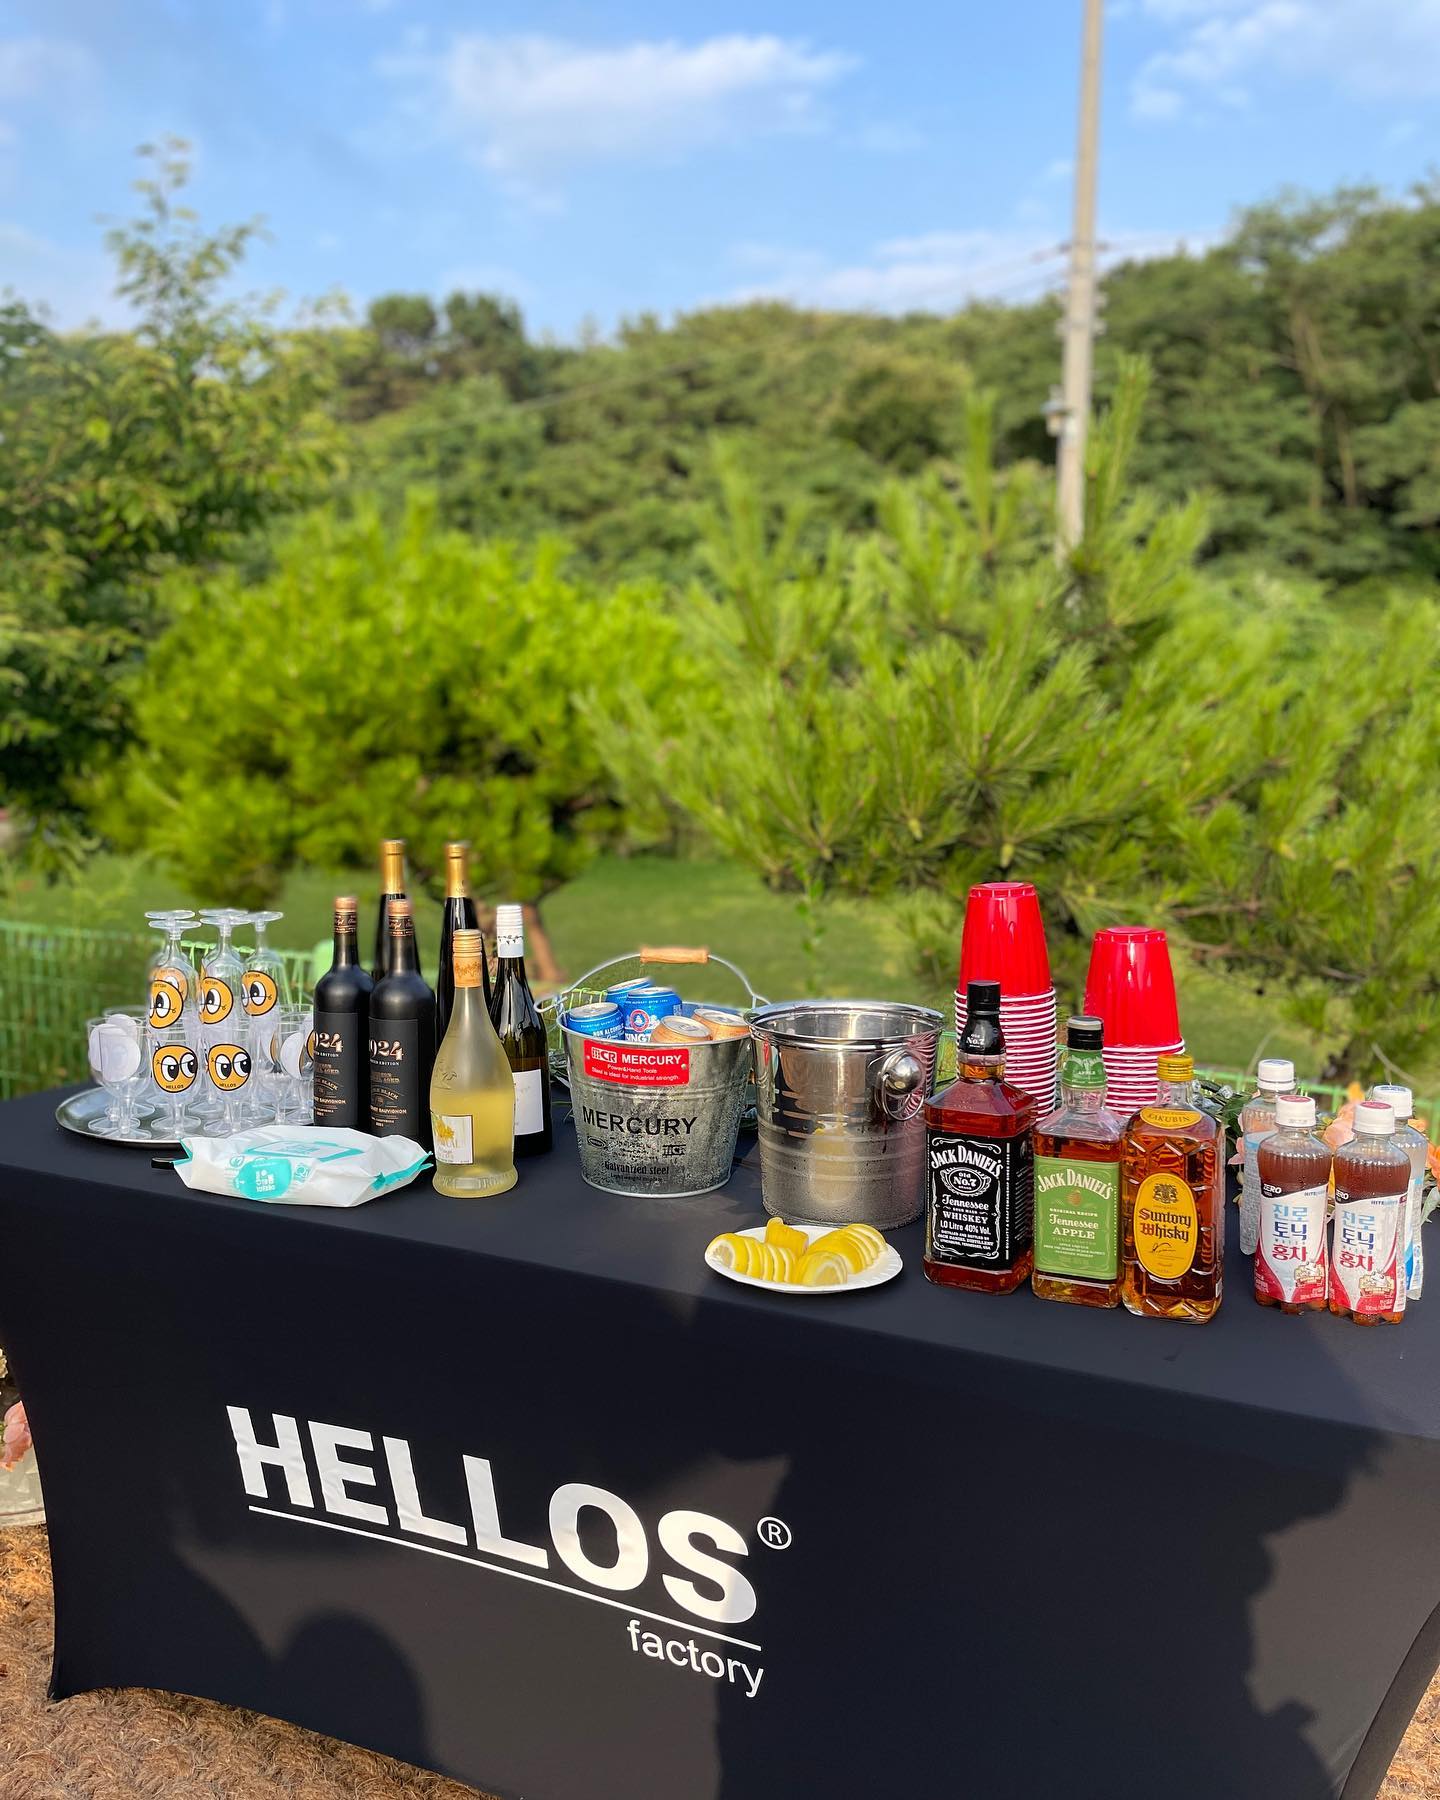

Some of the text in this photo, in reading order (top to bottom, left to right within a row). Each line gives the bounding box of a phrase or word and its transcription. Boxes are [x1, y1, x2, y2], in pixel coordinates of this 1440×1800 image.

[622, 1054, 682, 1065] MERCURY
[582, 1106, 697, 1135] MERCURY
[650, 1165, 669, 1175] steel
[930, 1145, 1004, 1179] JACK DANIEL'S
[953, 1177, 977, 1187] No.7
[1037, 1168, 1113, 1200] JACK DANIEL'S
[1263, 1183, 1282, 1195] ZERO
[942, 1194, 989, 1211] Tennessee
[942, 1211, 988, 1224] WHISKEY
[1049, 1213, 1099, 1229] Tennessee
[1138, 1208, 1192, 1229] Suntory
[1272, 1203, 1310, 1222] 진로
[1341, 1210, 1377, 1231] 진로
[949, 1222, 964, 1231] Litre
[964, 1224, 979, 1234] 40%
[1052, 1227, 1095, 1239] APPLE
[1140, 1222, 1189, 1244] Whisky
[1272, 1221, 1308, 1241] 토닉
[1341, 1228, 1375, 1248] 토닉
[1272, 1244, 1307, 1262] 홍차
[1339, 1250, 1376, 1272] 홍차
[226, 1404, 757, 1624] HELLOS
[627, 1619, 764, 1698] factory
